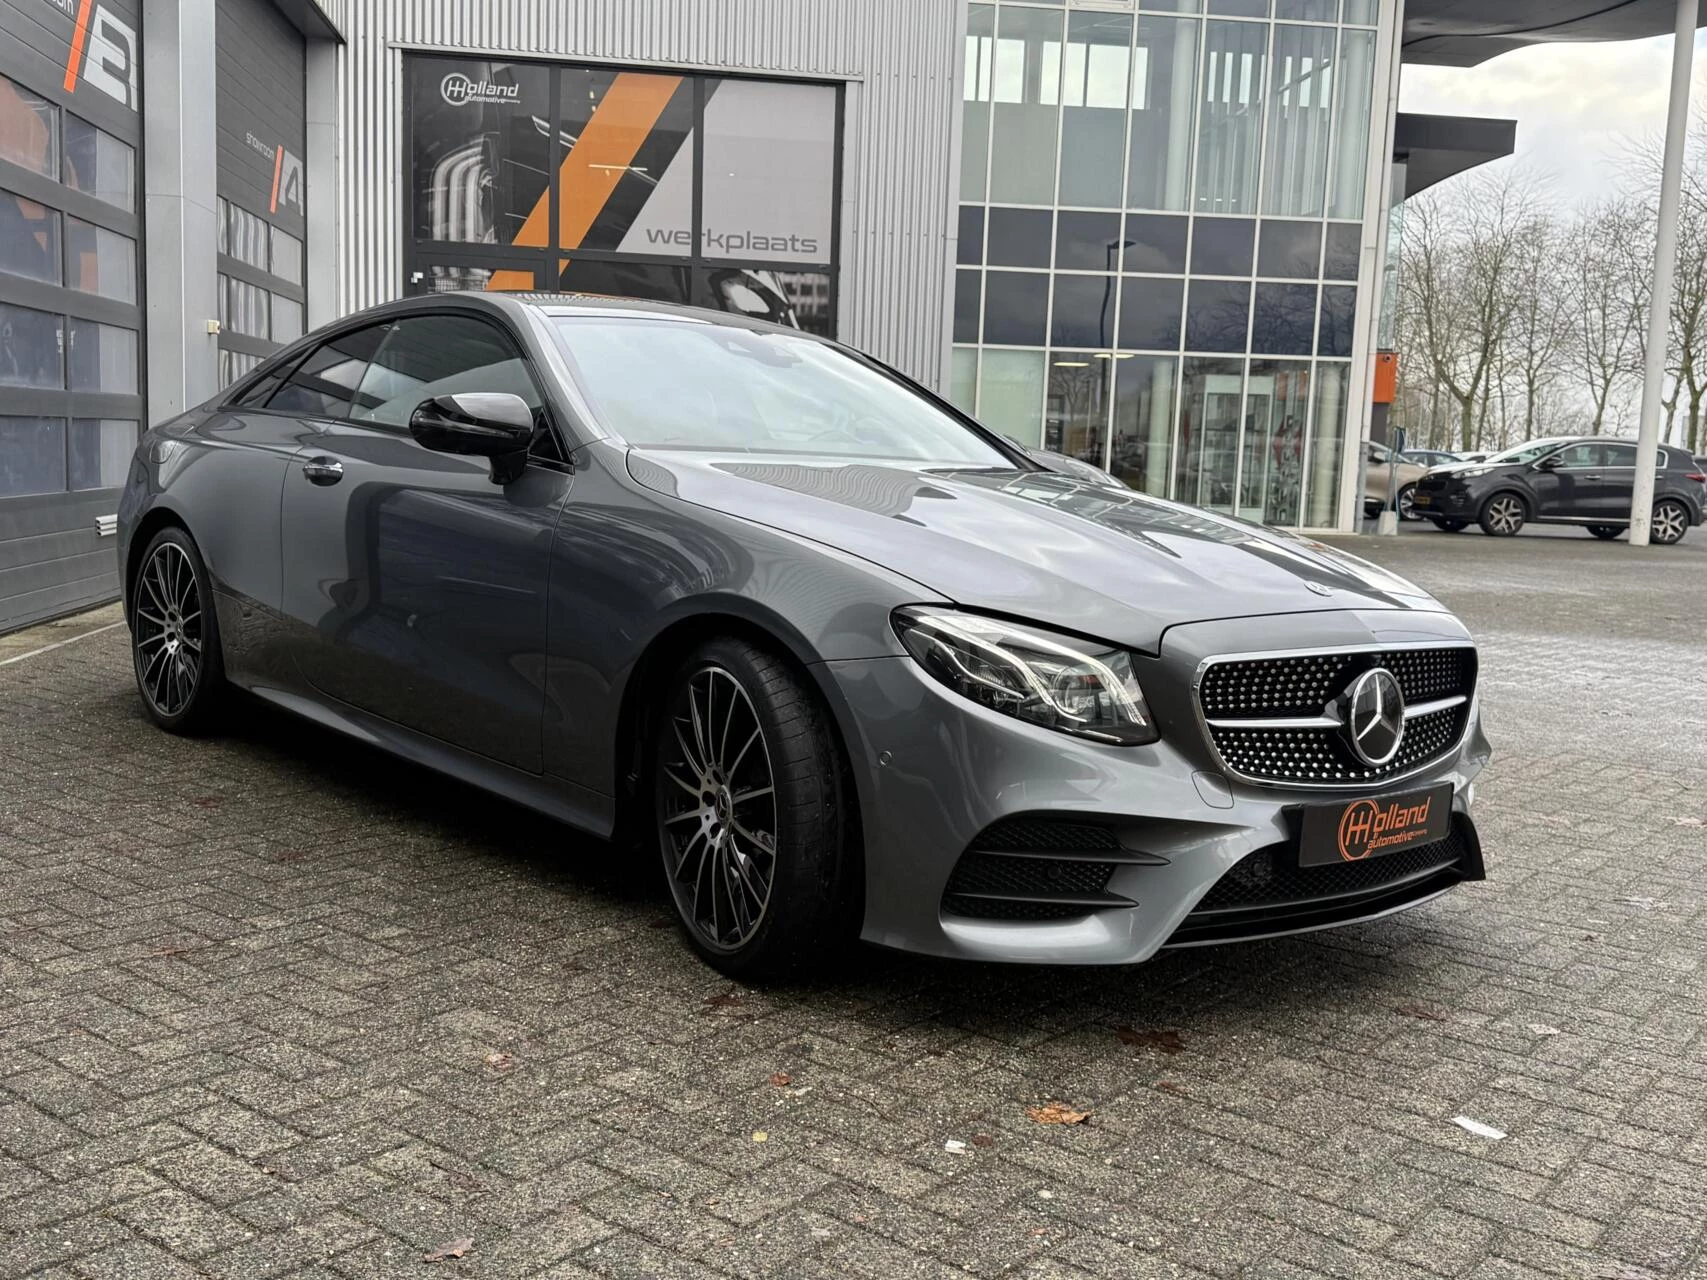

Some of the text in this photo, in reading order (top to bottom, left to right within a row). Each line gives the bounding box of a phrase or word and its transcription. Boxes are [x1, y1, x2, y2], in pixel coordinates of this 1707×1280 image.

[446, 79, 520, 98] Holland
[279, 149, 304, 217] A
[646, 228, 818, 254] wekplaats
[1344, 796, 1431, 847] Holland
[1367, 831, 1413, 849] automotive
